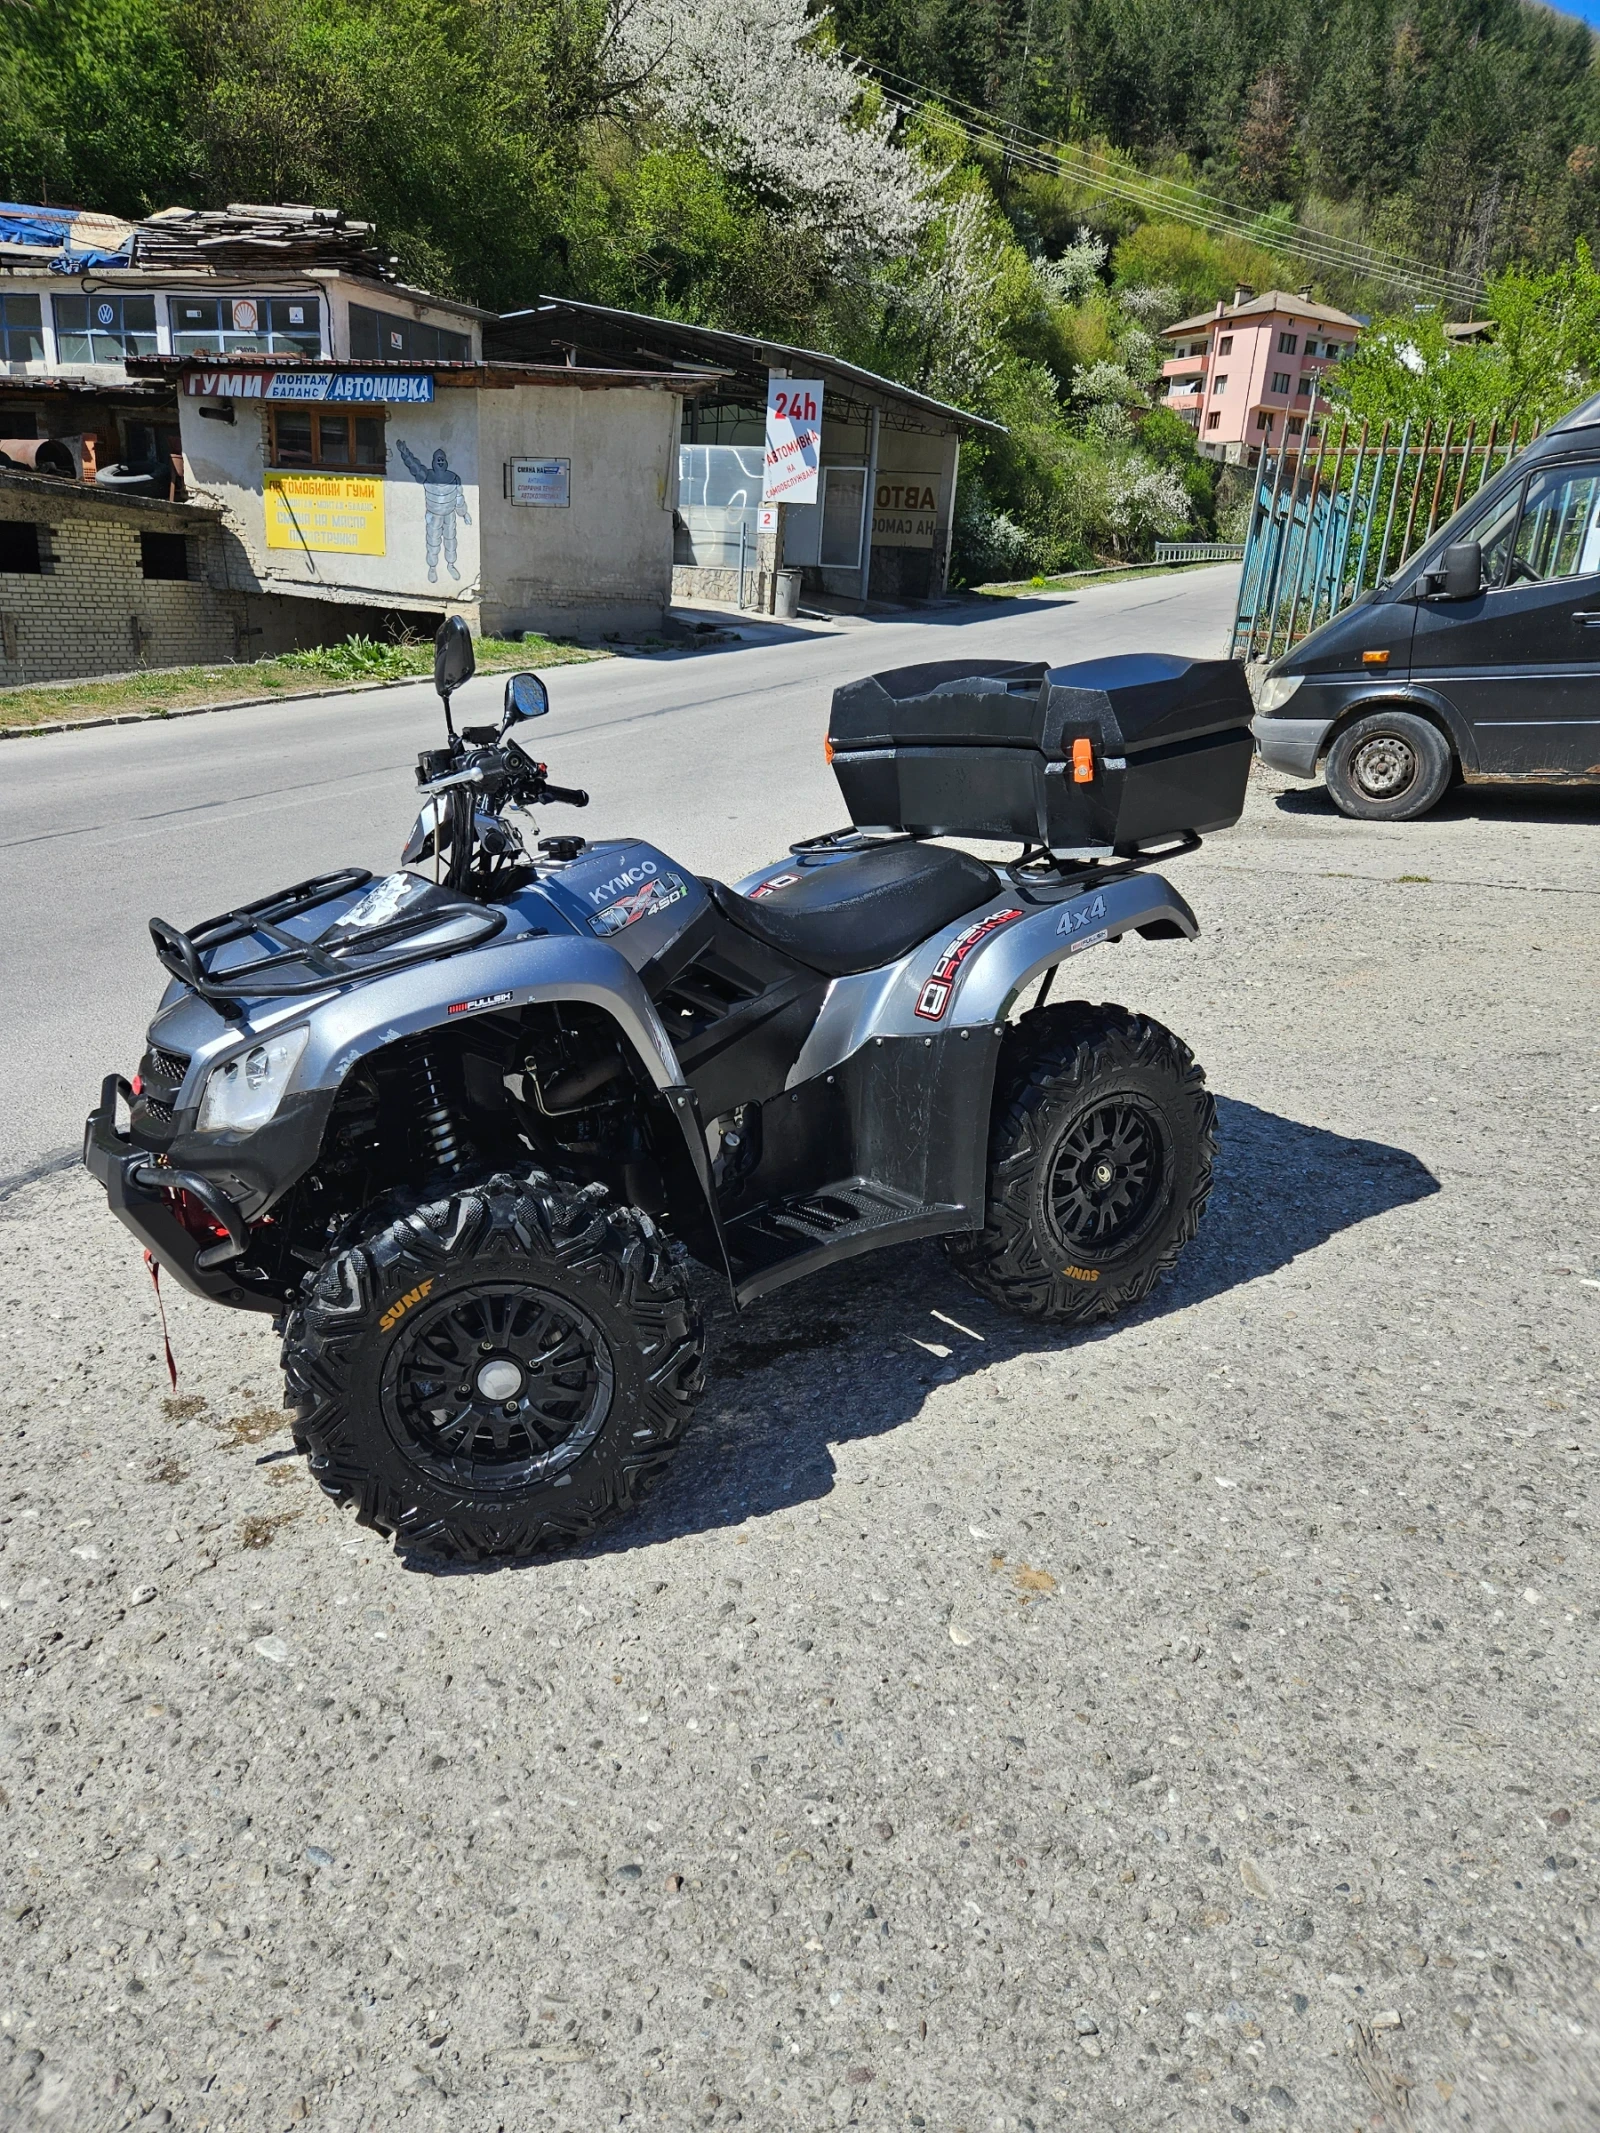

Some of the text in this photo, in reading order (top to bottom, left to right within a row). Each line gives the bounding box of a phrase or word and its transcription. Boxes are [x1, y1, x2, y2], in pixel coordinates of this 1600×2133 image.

[188, 373, 263, 397] ГУМИ
[275, 373, 328, 386] МОНТАЖ
[334, 375, 430, 400] АВТОМИВКА
[272, 387, 320, 398] БАЛАНС
[775, 392, 817, 421] 24h
[766, 429, 819, 466] АВТОМИВКА
[786, 463, 796, 473] НА
[346, 484, 375, 498] ГУМИ
[315, 513, 328, 527] НА
[332, 514, 366, 529] МАСЛА
[763, 513, 771, 525] 2
[588, 861, 657, 905] KYMCO
[647, 885, 688, 916] 450i
[1056, 894, 1107, 936] 4x4
[932, 908, 1013, 977] DESMO
[943, 910, 1023, 980] RACING
[1061, 1264, 1101, 1281] SUNF
[379, 1277, 435, 1333] SUNF
